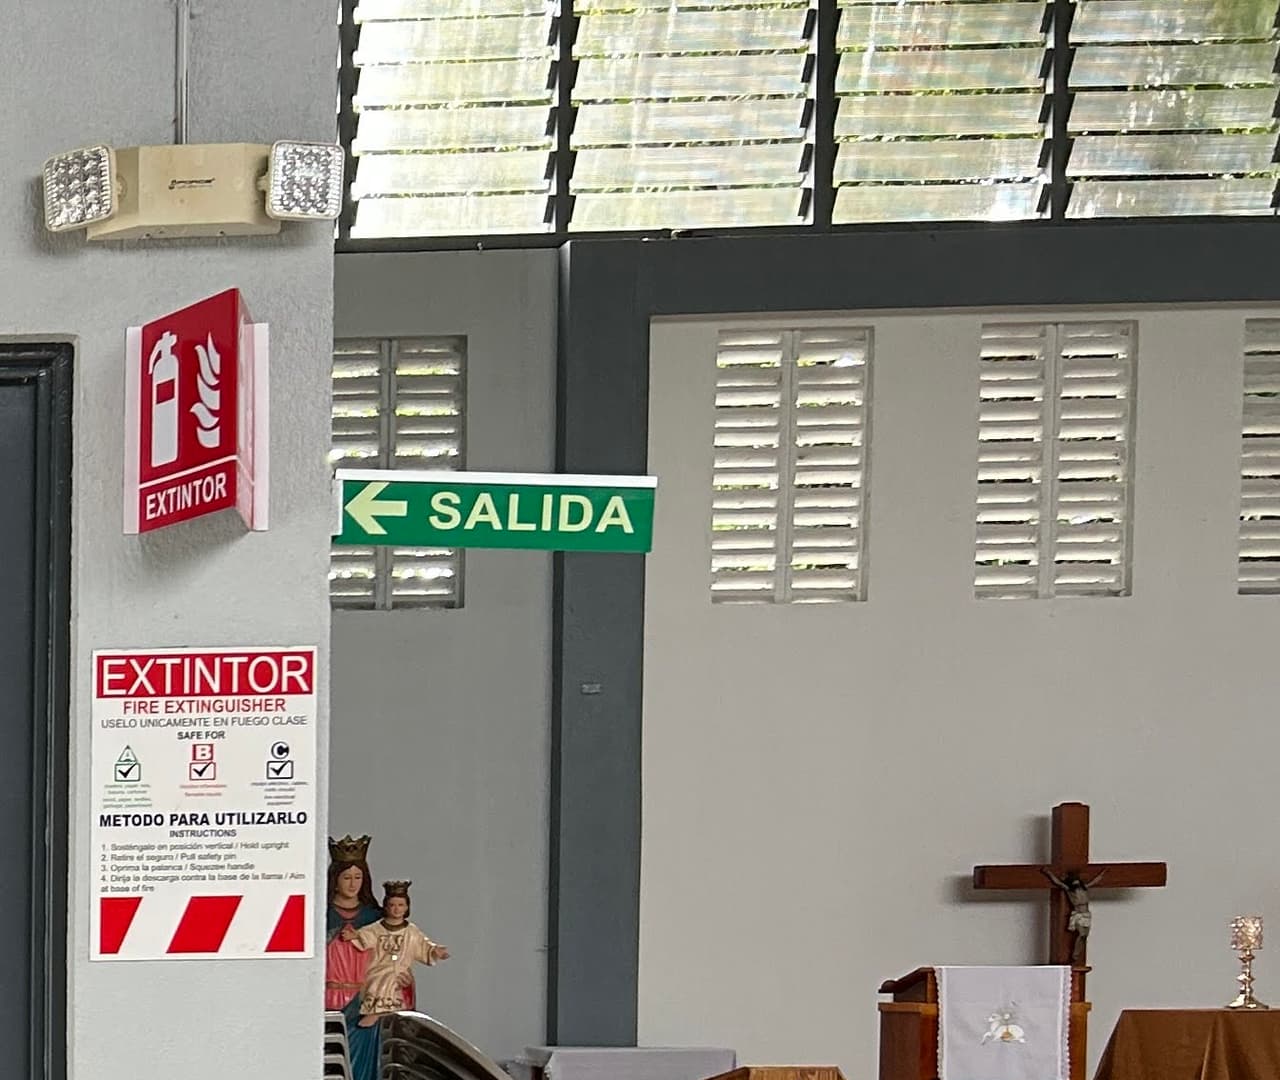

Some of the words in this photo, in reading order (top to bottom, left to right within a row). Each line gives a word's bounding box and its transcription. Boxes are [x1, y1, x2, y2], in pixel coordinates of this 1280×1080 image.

[146, 472, 227, 521] EXTINTOR
[428, 491, 635, 534] SALIDA
[102, 655, 310, 696] EXTINTOR
[123, 700, 159, 715] FIRE
[164, 698, 286, 714] EXTINGUISHER
[101, 719, 137, 729] USELO
[140, 717, 209, 728] UNICAMENTE
[214, 717, 228, 727] EN
[231, 716, 269, 726] FUEGO
[272, 715, 307, 726] CLASE
[177, 731, 204, 740] SAFE
[205, 731, 225, 740] FOR
[271, 741, 289, 759] C
[99, 813, 165, 827] METODO
[169, 813, 210, 827] PARA
[215, 811, 308, 826] UTILIZARLO
[169, 829, 237, 838] INSTRUCTIONS
